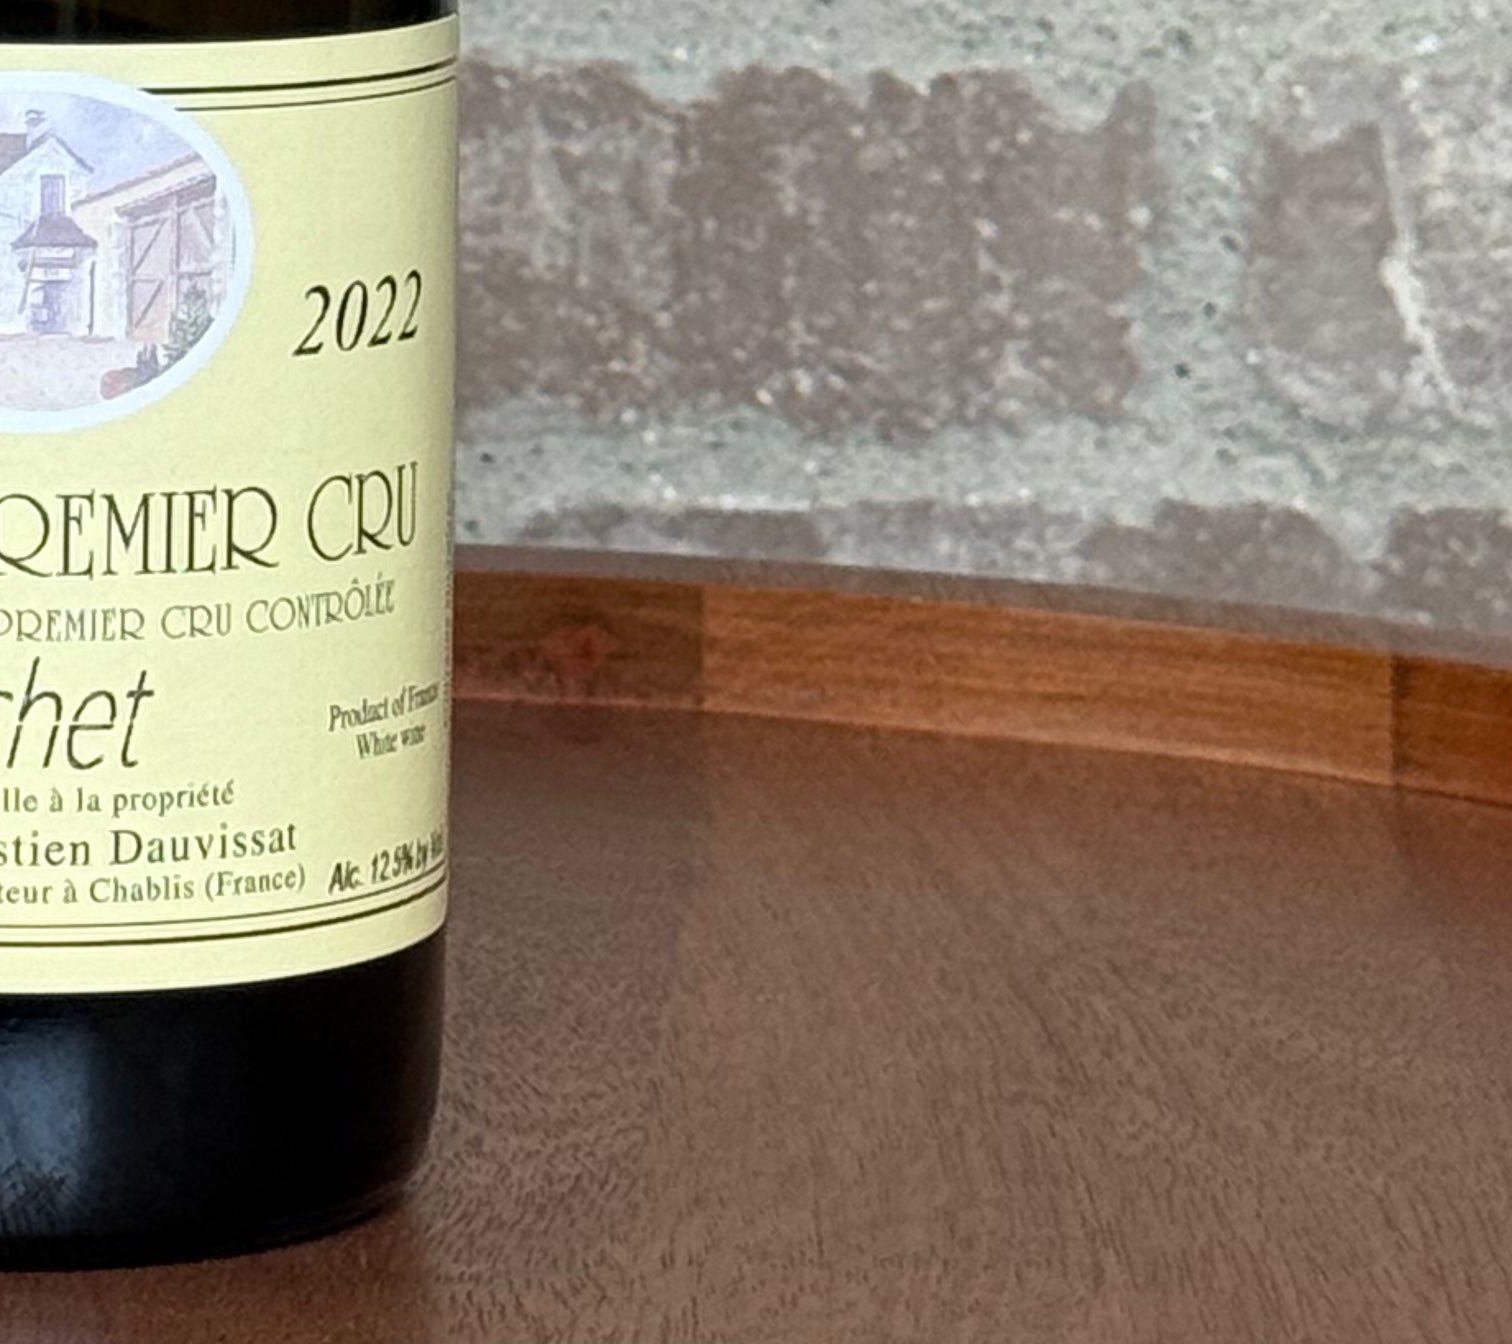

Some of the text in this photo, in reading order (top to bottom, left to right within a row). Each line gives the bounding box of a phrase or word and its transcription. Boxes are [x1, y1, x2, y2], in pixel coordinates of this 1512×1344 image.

[292, 269, 422, 357] 2022
[307, 460, 418, 562] CRU
[160, 602, 232, 640] CRU
[246, 570, 396, 634] CONTRÔLÉE
[329, 698, 389, 732] Product
[391, 685, 407, 719] of
[49, 787, 64, 813] à
[76, 787, 102, 813] la
[112, 779, 235, 819] propriété
[109, 822, 297, 866] Dauvissat
[63, 878, 78, 904] à
[89, 874, 196, 904] Chablis
[204, 863, 306, 902] (France)
